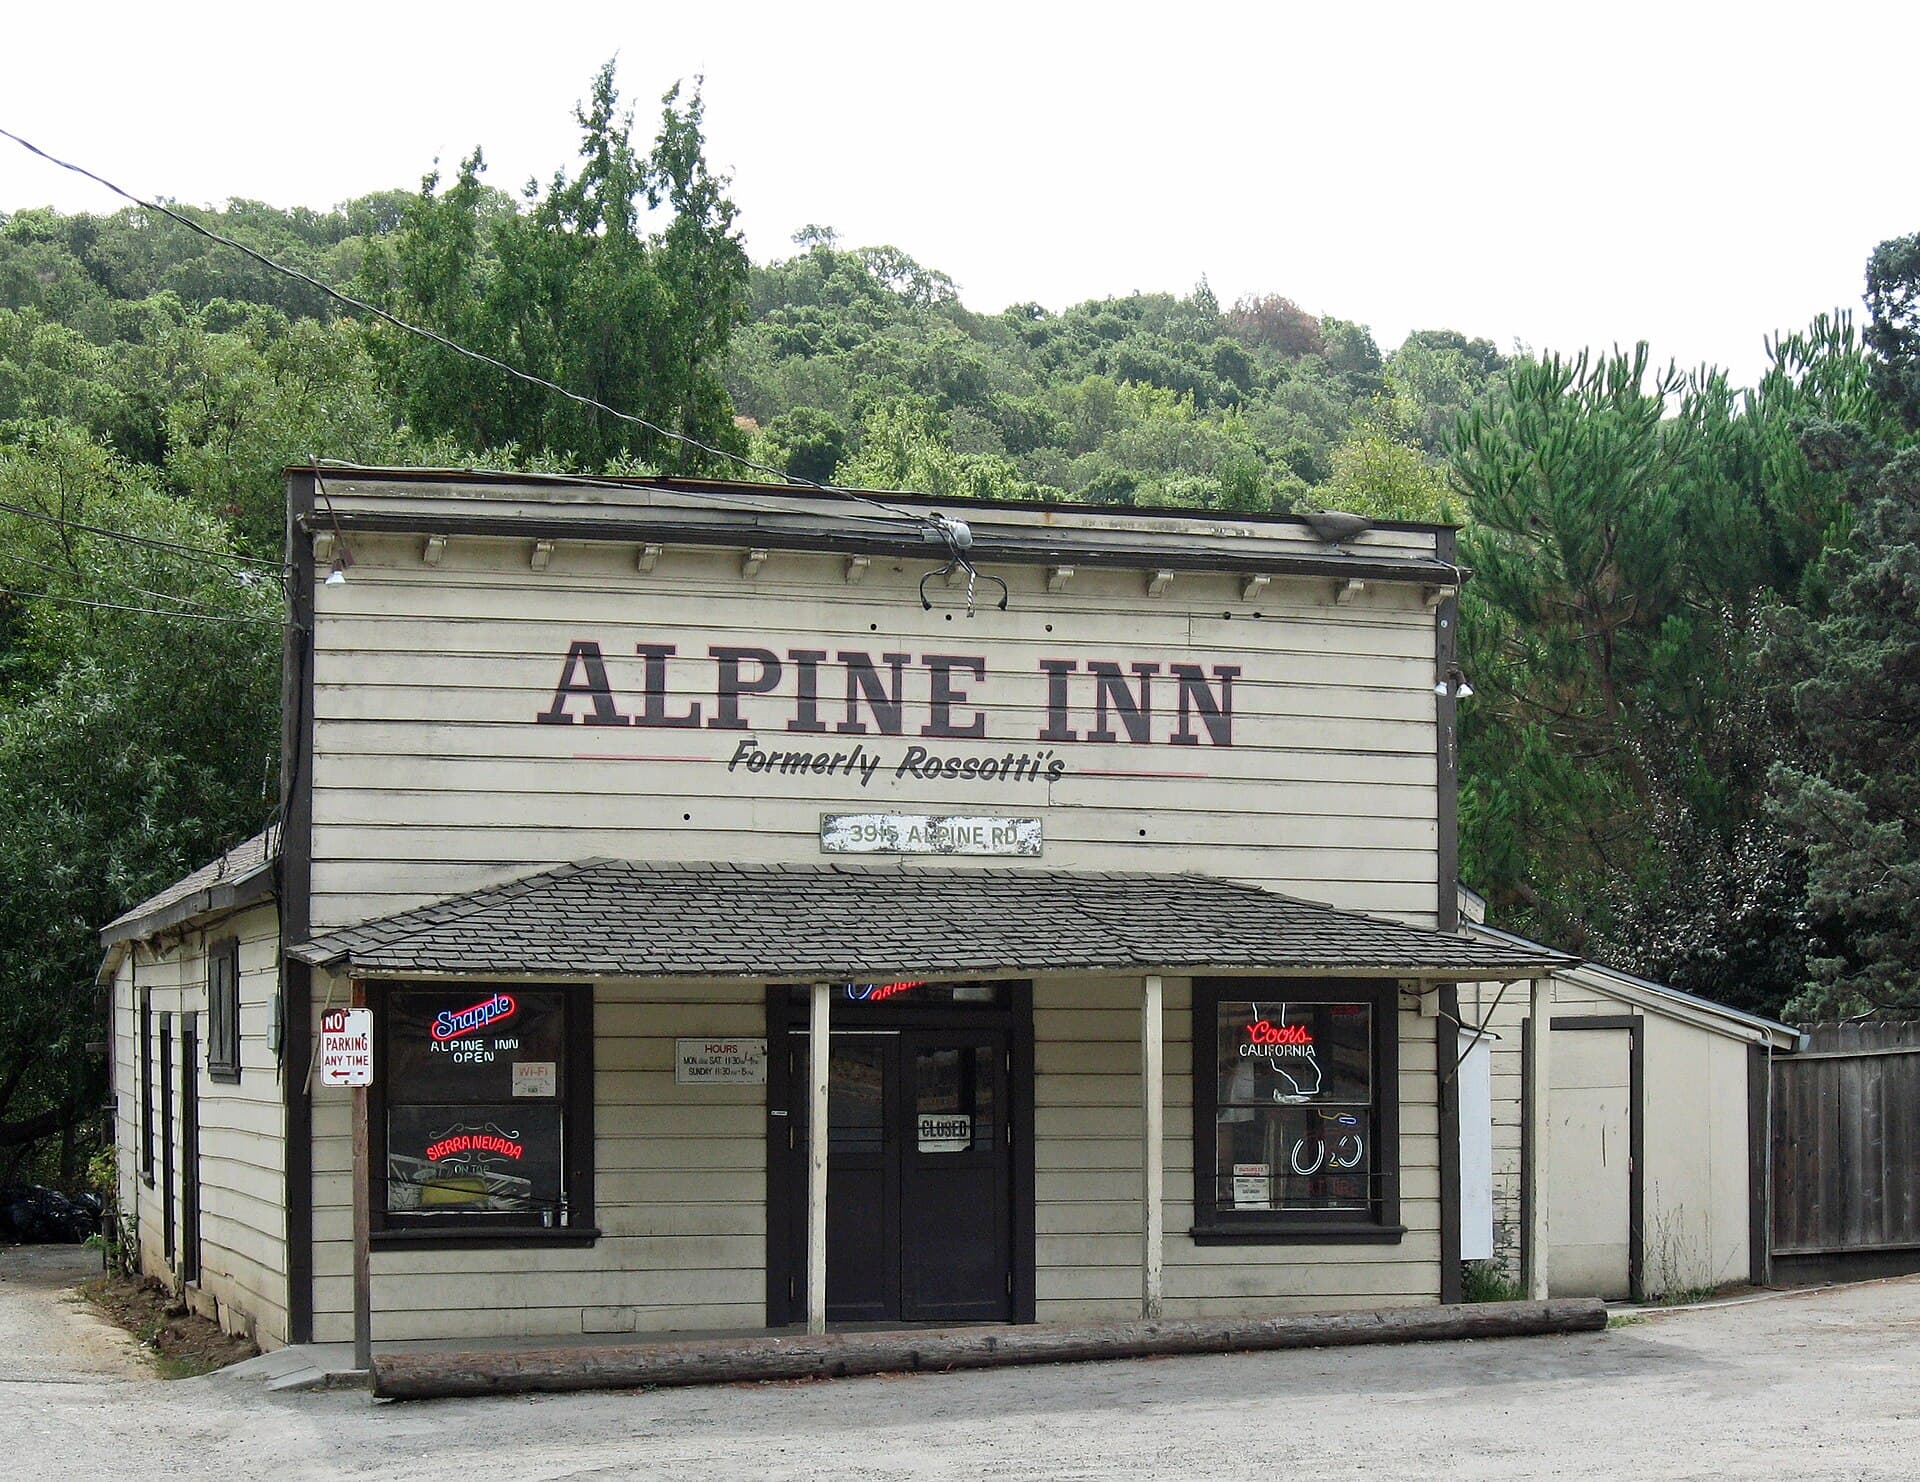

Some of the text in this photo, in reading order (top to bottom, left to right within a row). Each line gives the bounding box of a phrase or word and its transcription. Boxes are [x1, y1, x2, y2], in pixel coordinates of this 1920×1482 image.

[536, 640, 1242, 747] ALPINE INN
[727, 740, 1066, 787] Formerly Rossotti's
[850, 824, 899, 843] 3915
[908, 825, 984, 845] ALPINE
[325, 1013, 343, 1030] NO
[436, 993, 509, 1037] Snapple
[1247, 1020, 1313, 1043] Coors
[326, 1037, 368, 1051] PARKING
[431, 1039, 519, 1052] ALPINE INN
[704, 1044, 738, 1054] HOURS
[1240, 1044, 1316, 1057] CALIFORNIA
[324, 1056, 369, 1066] ANY TIME
[453, 1052, 495, 1063] OPEN
[688, 1067, 712, 1076] SUNDAY
[922, 1120, 967, 1138] CLOSED
[426, 1135, 523, 1162] SIERRA NEVADA
